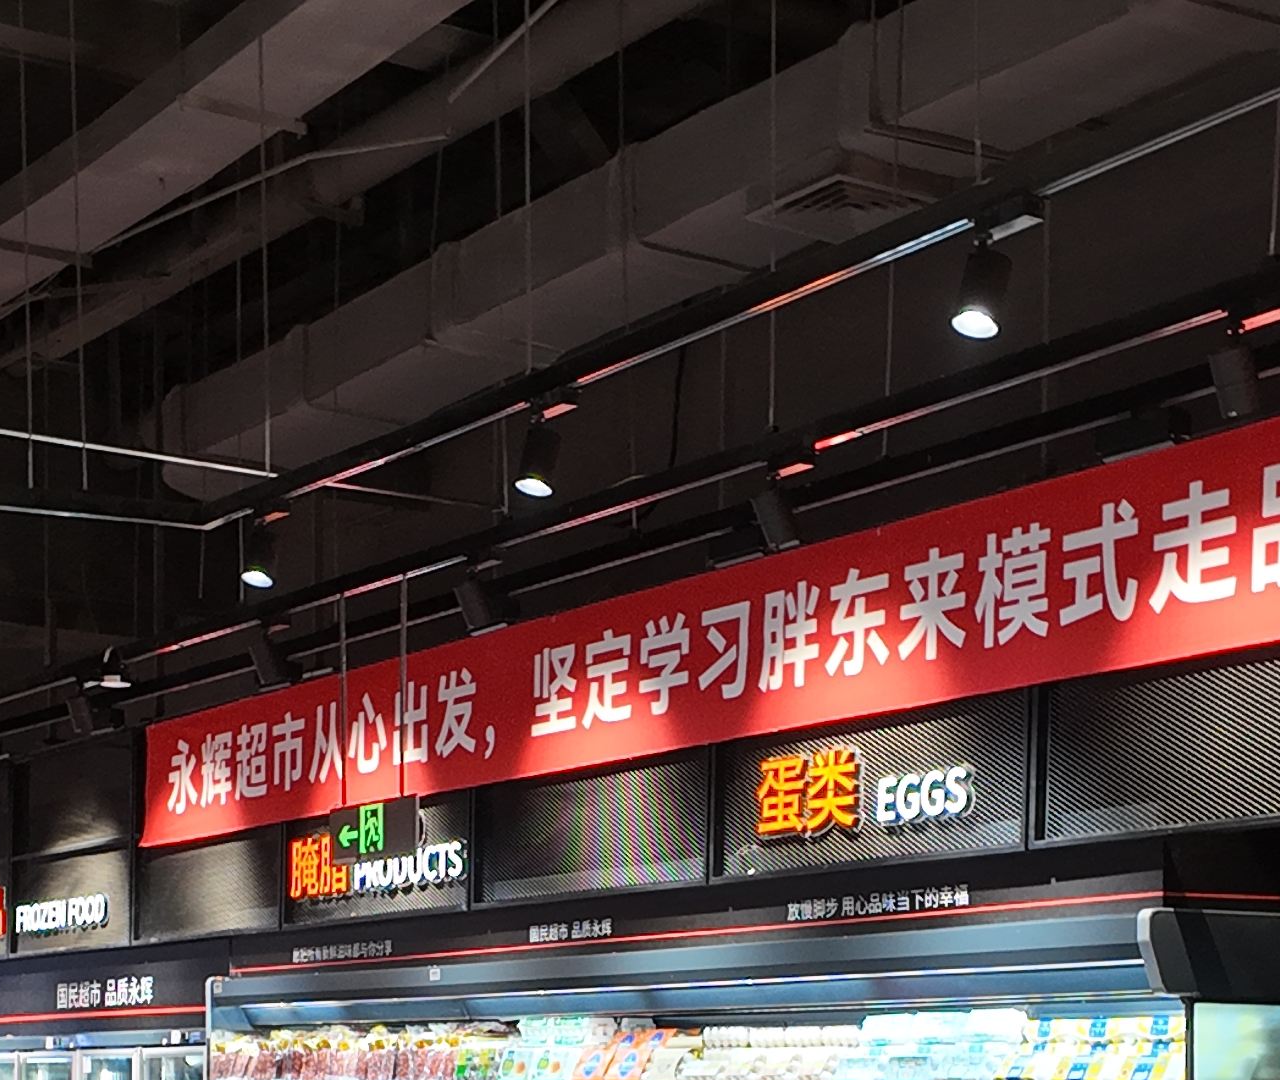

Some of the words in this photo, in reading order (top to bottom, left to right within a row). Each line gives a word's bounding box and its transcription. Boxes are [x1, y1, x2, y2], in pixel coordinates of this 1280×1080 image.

[756, 745, 857, 836] 蛋类
[875, 764, 971, 824] EGGS
[15, 899, 68, 934] FROZEN
[67, 893, 109, 928] FOOD
[841, 884, 970, 916] 用心品味当下的幸福
[56, 982, 101, 1009] 国民超市
[105, 977, 154, 1006] 品质永辉
